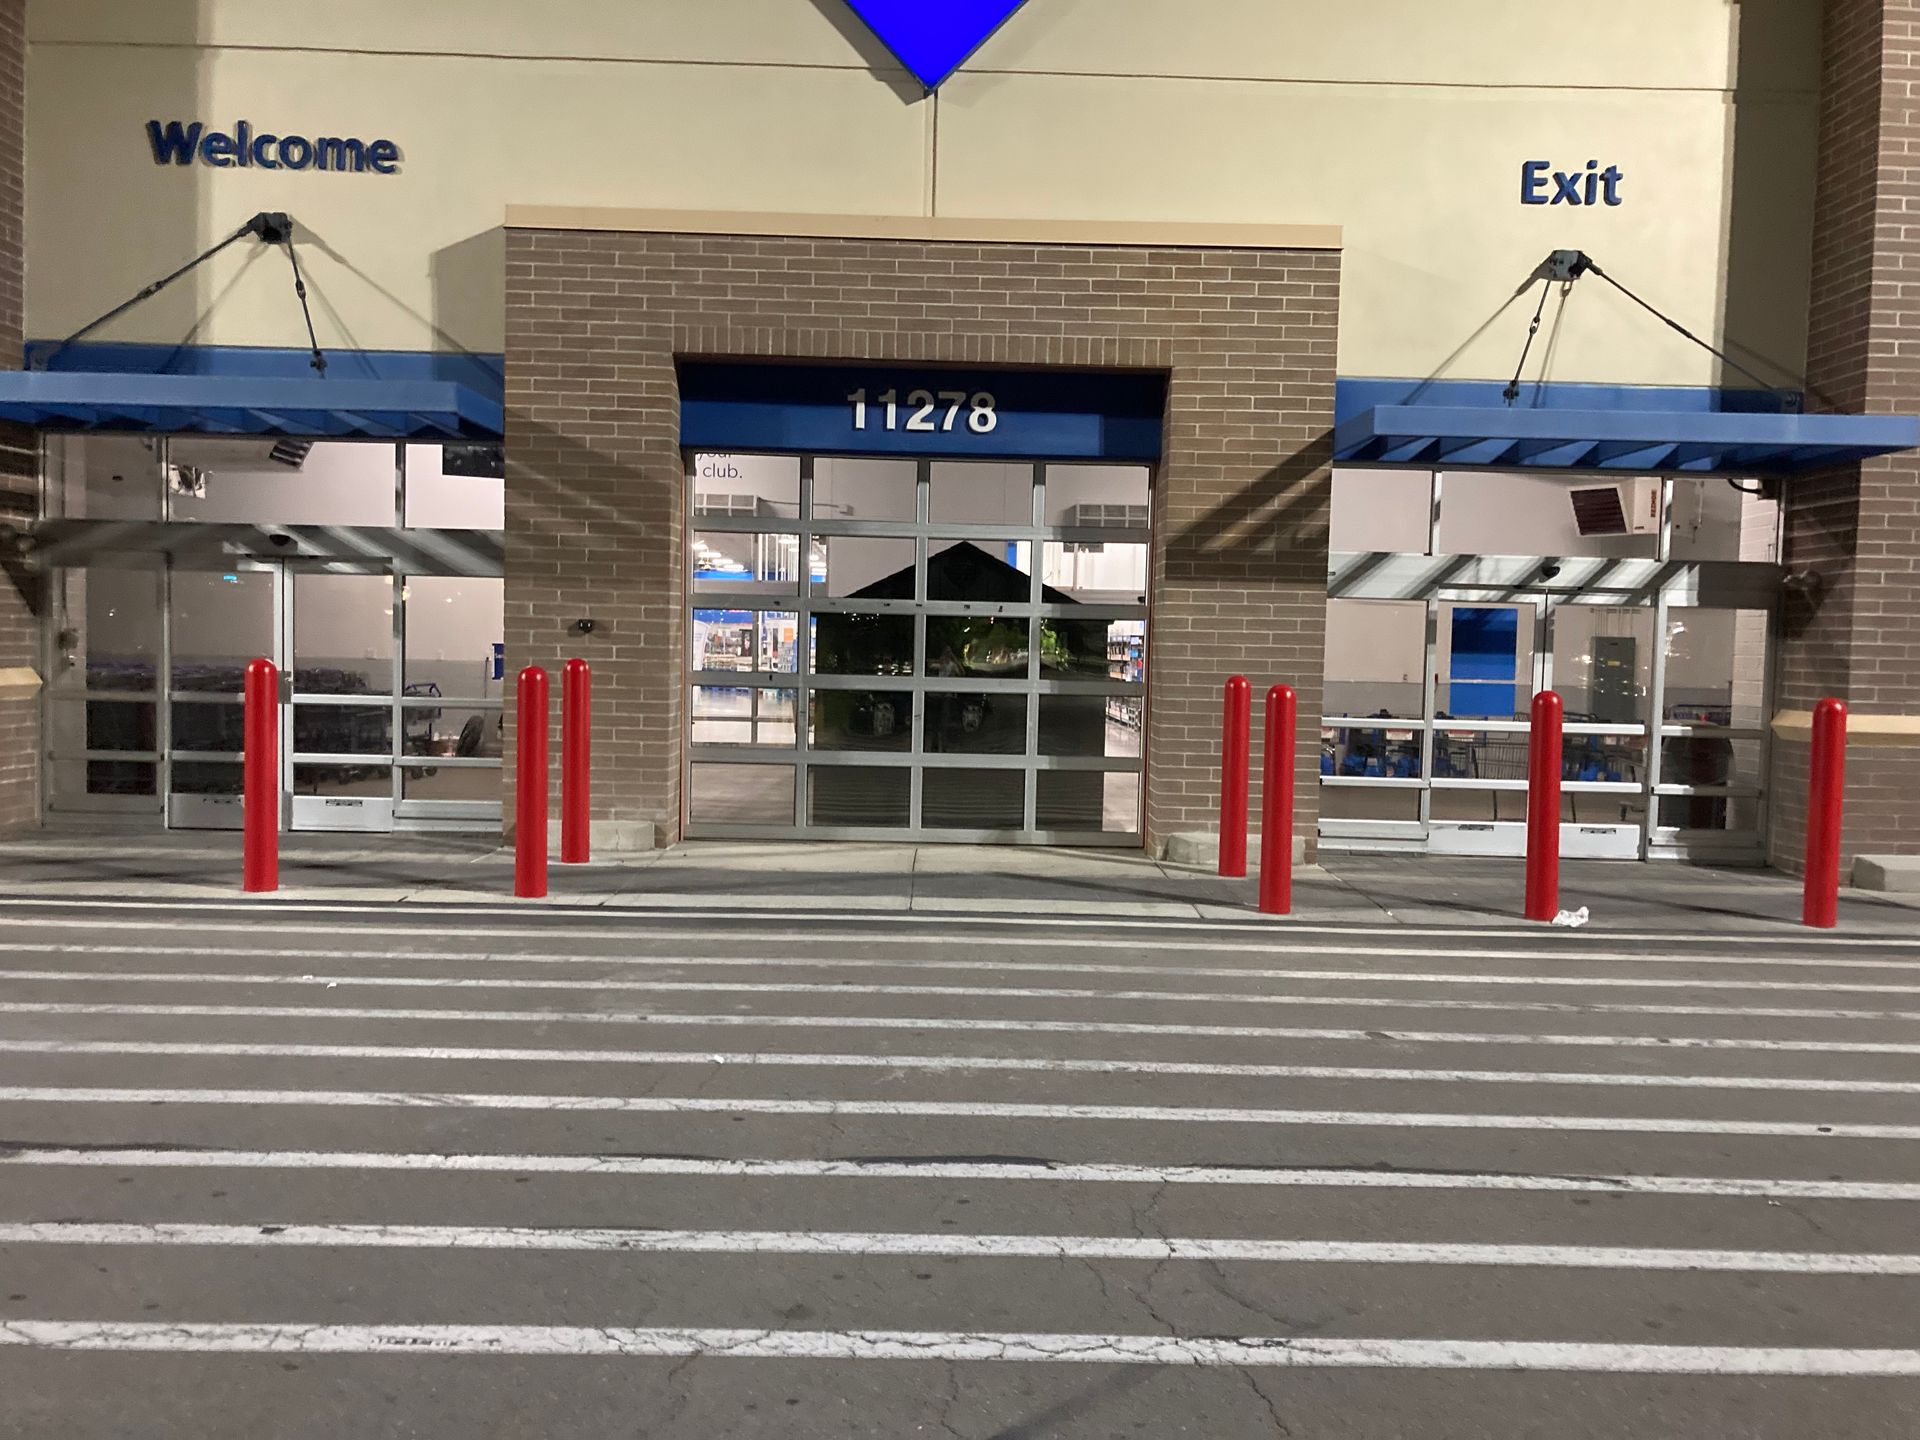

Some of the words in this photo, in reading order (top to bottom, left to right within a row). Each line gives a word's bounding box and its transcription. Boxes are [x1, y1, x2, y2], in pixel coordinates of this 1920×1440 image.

[145, 119, 401, 174] Welcome
[1521, 160, 1623, 206] Exit
[847, 388, 998, 433] 11278
[702, 463, 743, 479] club.
